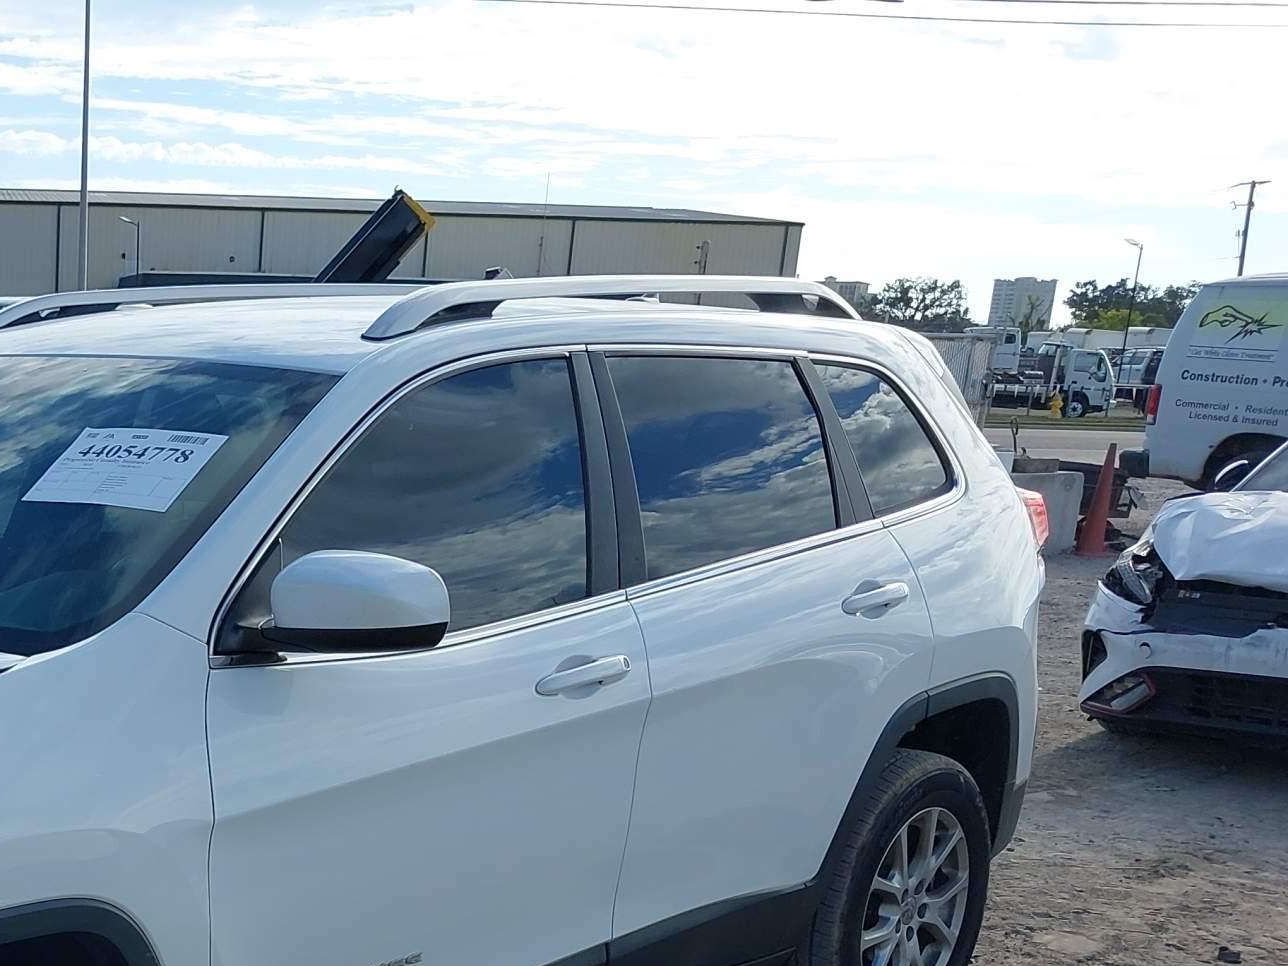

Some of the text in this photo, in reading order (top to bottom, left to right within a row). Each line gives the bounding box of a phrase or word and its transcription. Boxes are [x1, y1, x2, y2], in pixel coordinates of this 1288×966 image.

[1181, 370, 1258, 386] Construction
[1175, 399, 1229, 411] Commercial
[1189, 411, 1278, 427] Licensed & Insured
[78, 444, 194, 463] 44054778
